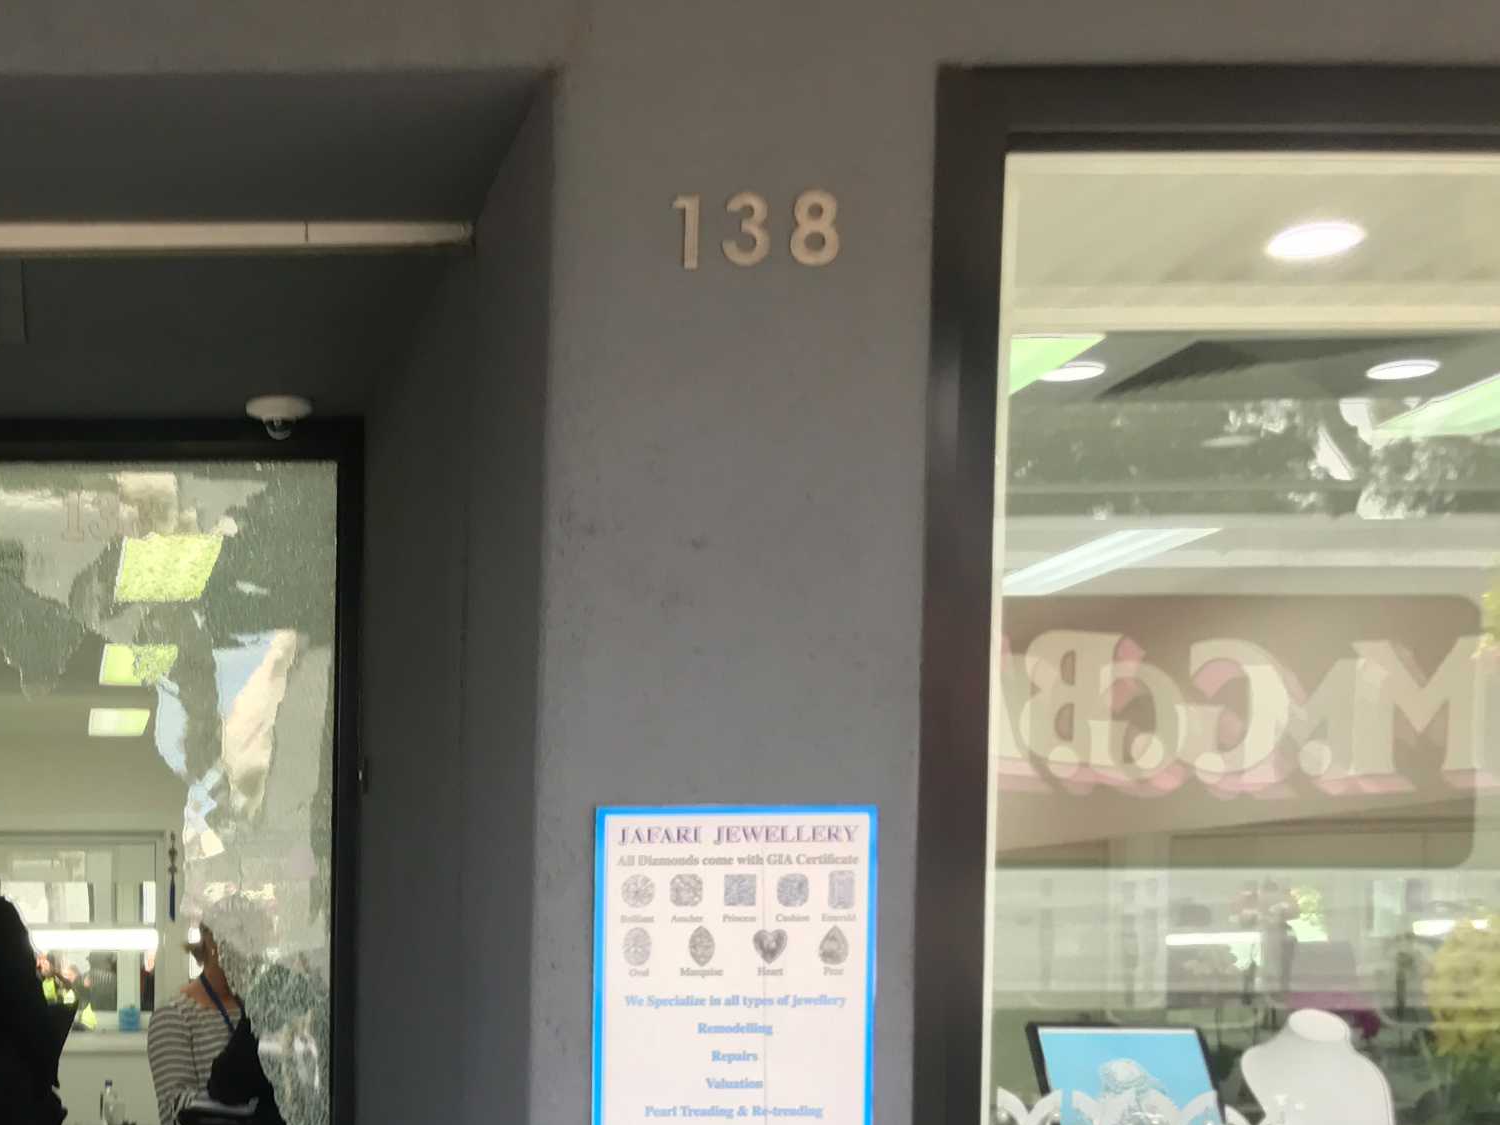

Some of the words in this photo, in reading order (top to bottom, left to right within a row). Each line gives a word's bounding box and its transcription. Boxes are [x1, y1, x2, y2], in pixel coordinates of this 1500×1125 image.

[672, 190, 840, 270] 138
[618, 826, 702, 846] JAFARI
[713, 825, 859, 846] JEWELLERY
[617, 855, 636, 867] All
[638, 855, 700, 867] Diamonds
[702, 857, 734, 866] come
[737, 854, 764, 866] with
[766, 853, 793, 866] GIA
[796, 853, 859, 866] Certificate
[628, 967, 650, 977] Oval
[757, 966, 783, 977] Heart
[625, 995, 644, 1006] We
[709, 995, 721, 1006] in
[723, 995, 740, 1006] all
[742, 996, 774, 1009] types
[777, 994, 791, 1006] of
[791, 994, 847, 1009] jewellery
[697, 1022, 773, 1036] Remodelling
[711, 1050, 758, 1064] Repairs
[705, 1077, 764, 1090] Valuation
[645, 1105, 678, 1117] Pearl
[737, 1105, 748, 1117] &
